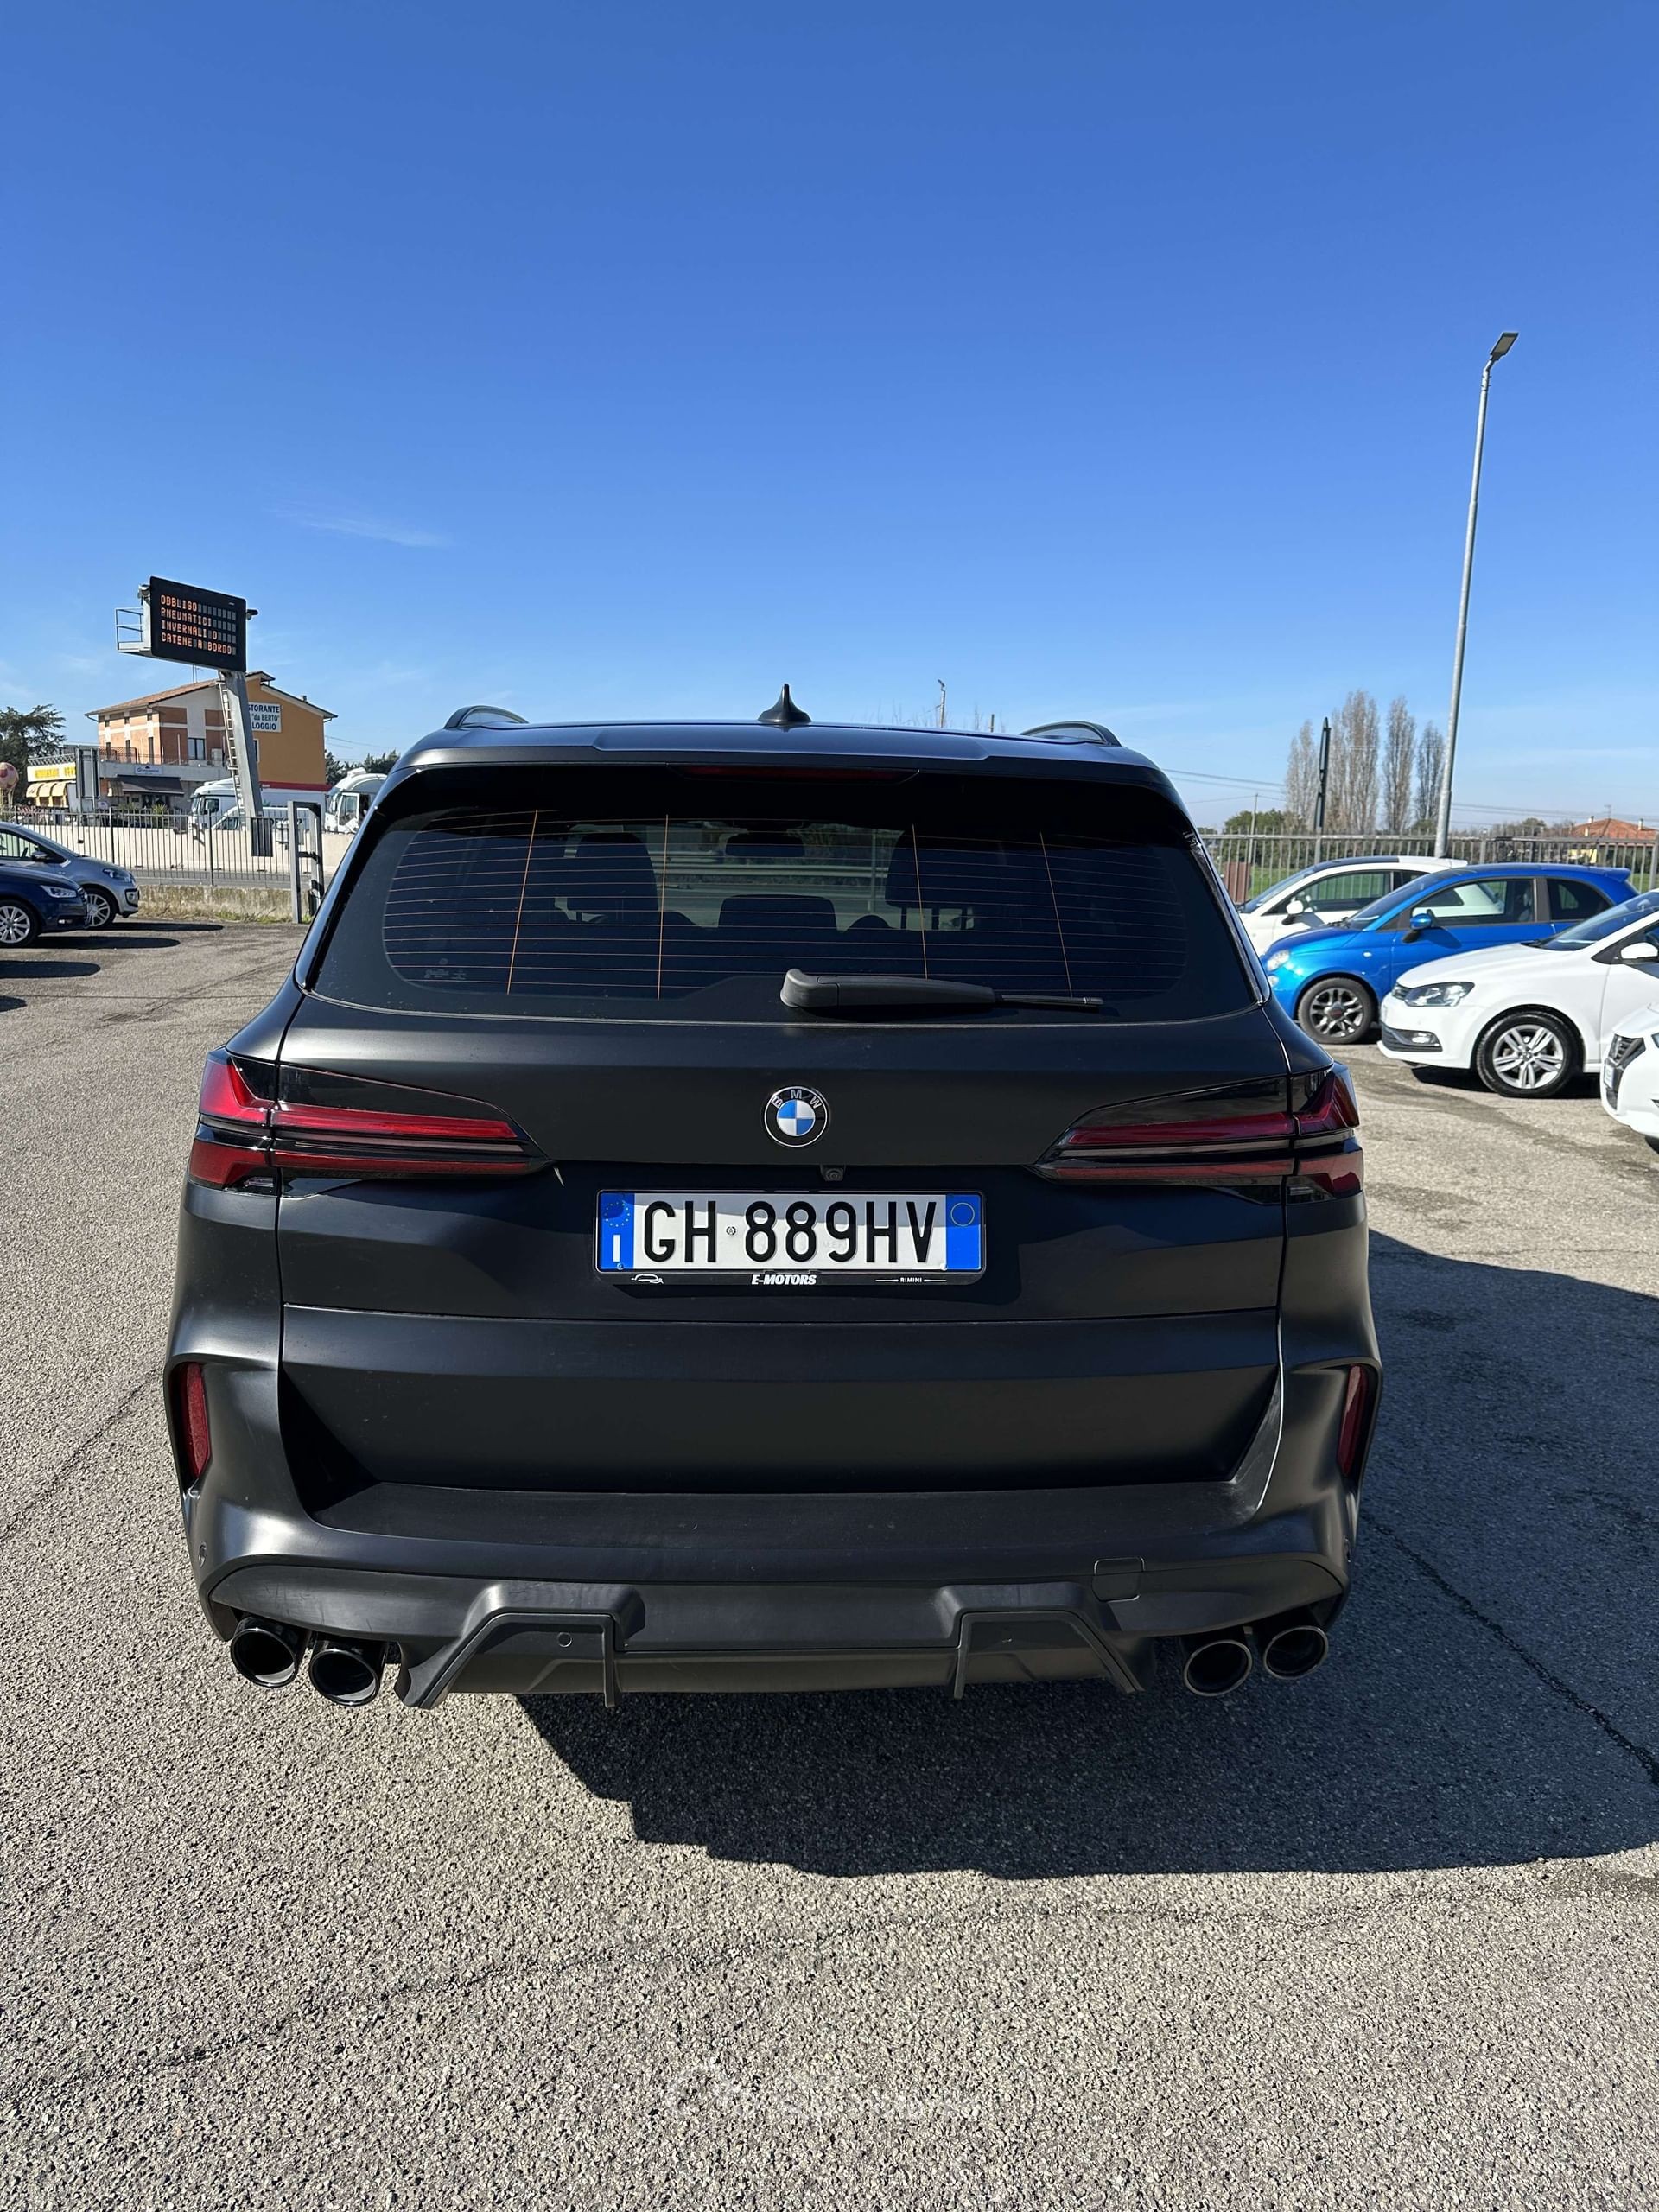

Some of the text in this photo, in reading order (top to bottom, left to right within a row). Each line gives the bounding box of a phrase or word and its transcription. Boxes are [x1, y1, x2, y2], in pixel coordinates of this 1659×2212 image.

[161, 594, 197, 612] OBBLIGO
[161, 607, 212, 626] PNEUMATICI
[162, 620, 207, 638] INVERNALI
[162, 632, 232, 654] CATENE A BORDO
[771, 1089, 822, 1109] BMW
[644, 1200, 938, 1263] GH 889HV
[751, 1274, 817, 1285] E-MOTORS
